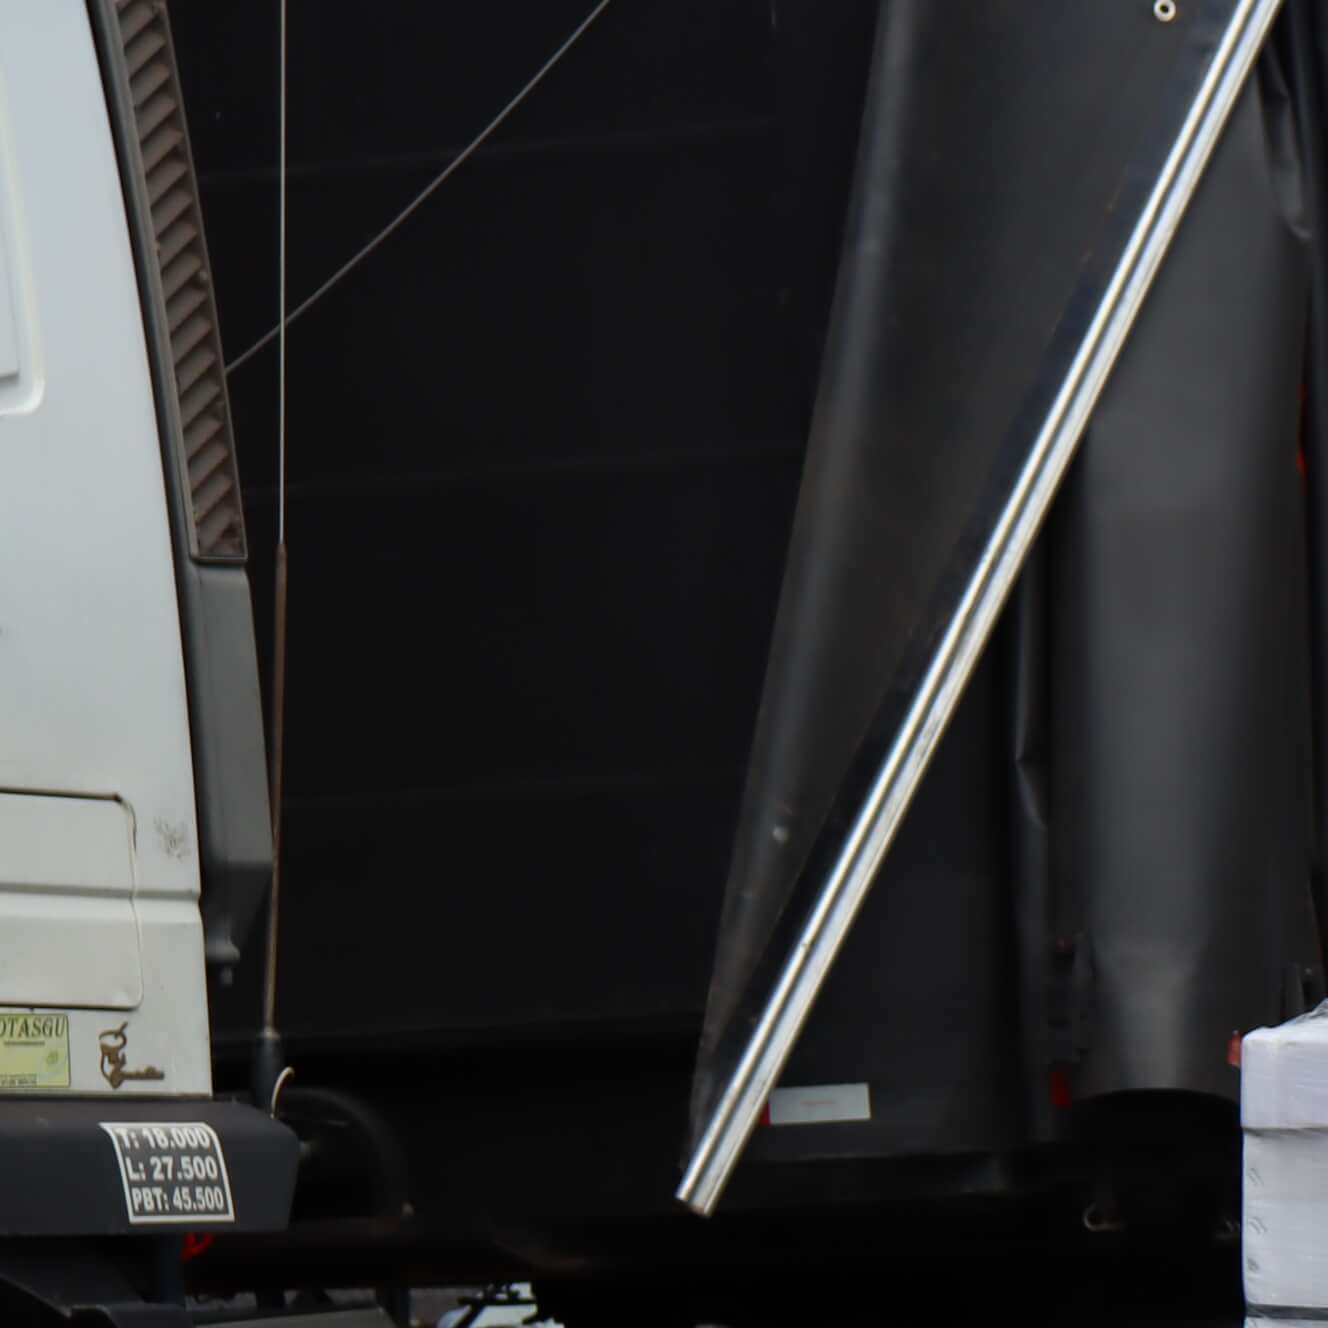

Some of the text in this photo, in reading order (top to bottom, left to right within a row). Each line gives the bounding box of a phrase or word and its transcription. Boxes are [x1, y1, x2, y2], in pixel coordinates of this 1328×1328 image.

[125, 1156, 218, 1180] L: 27.500
[131, 1185, 224, 1212] PBT: 45.500
